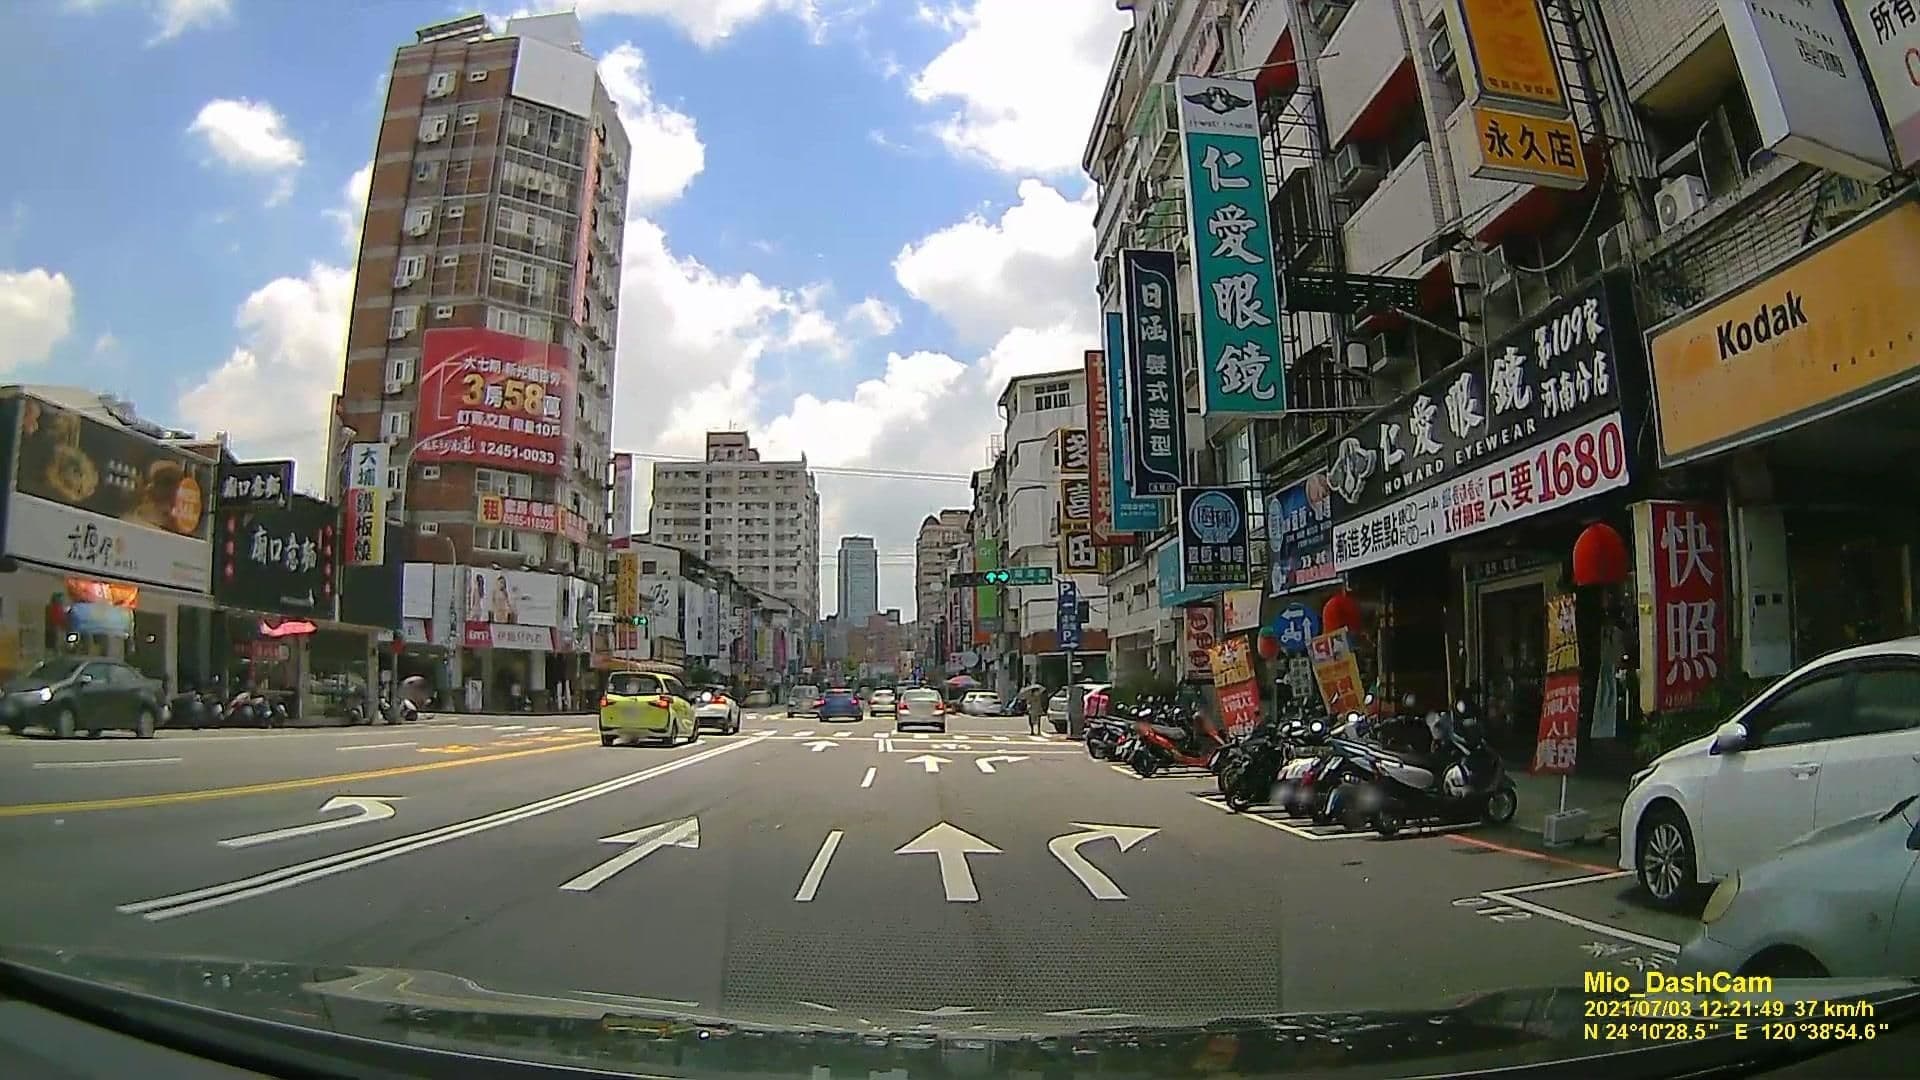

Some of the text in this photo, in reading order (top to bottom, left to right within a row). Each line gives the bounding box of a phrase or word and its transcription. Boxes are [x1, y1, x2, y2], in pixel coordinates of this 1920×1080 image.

[1485, 119, 1576, 168] 永久店
[1200, 143, 1276, 401] 仁愛眼鏡
[1717, 290, 1808, 360] Kodak
[1379, 346, 1533, 473] 仁愛眼鏡
[1540, 350, 1609, 419] 河南分店
[1384, 459, 1445, 495] HOWARD
[1455, 418, 1537, 466] EYEWEAR
[1661, 511, 1717, 685] 快照
